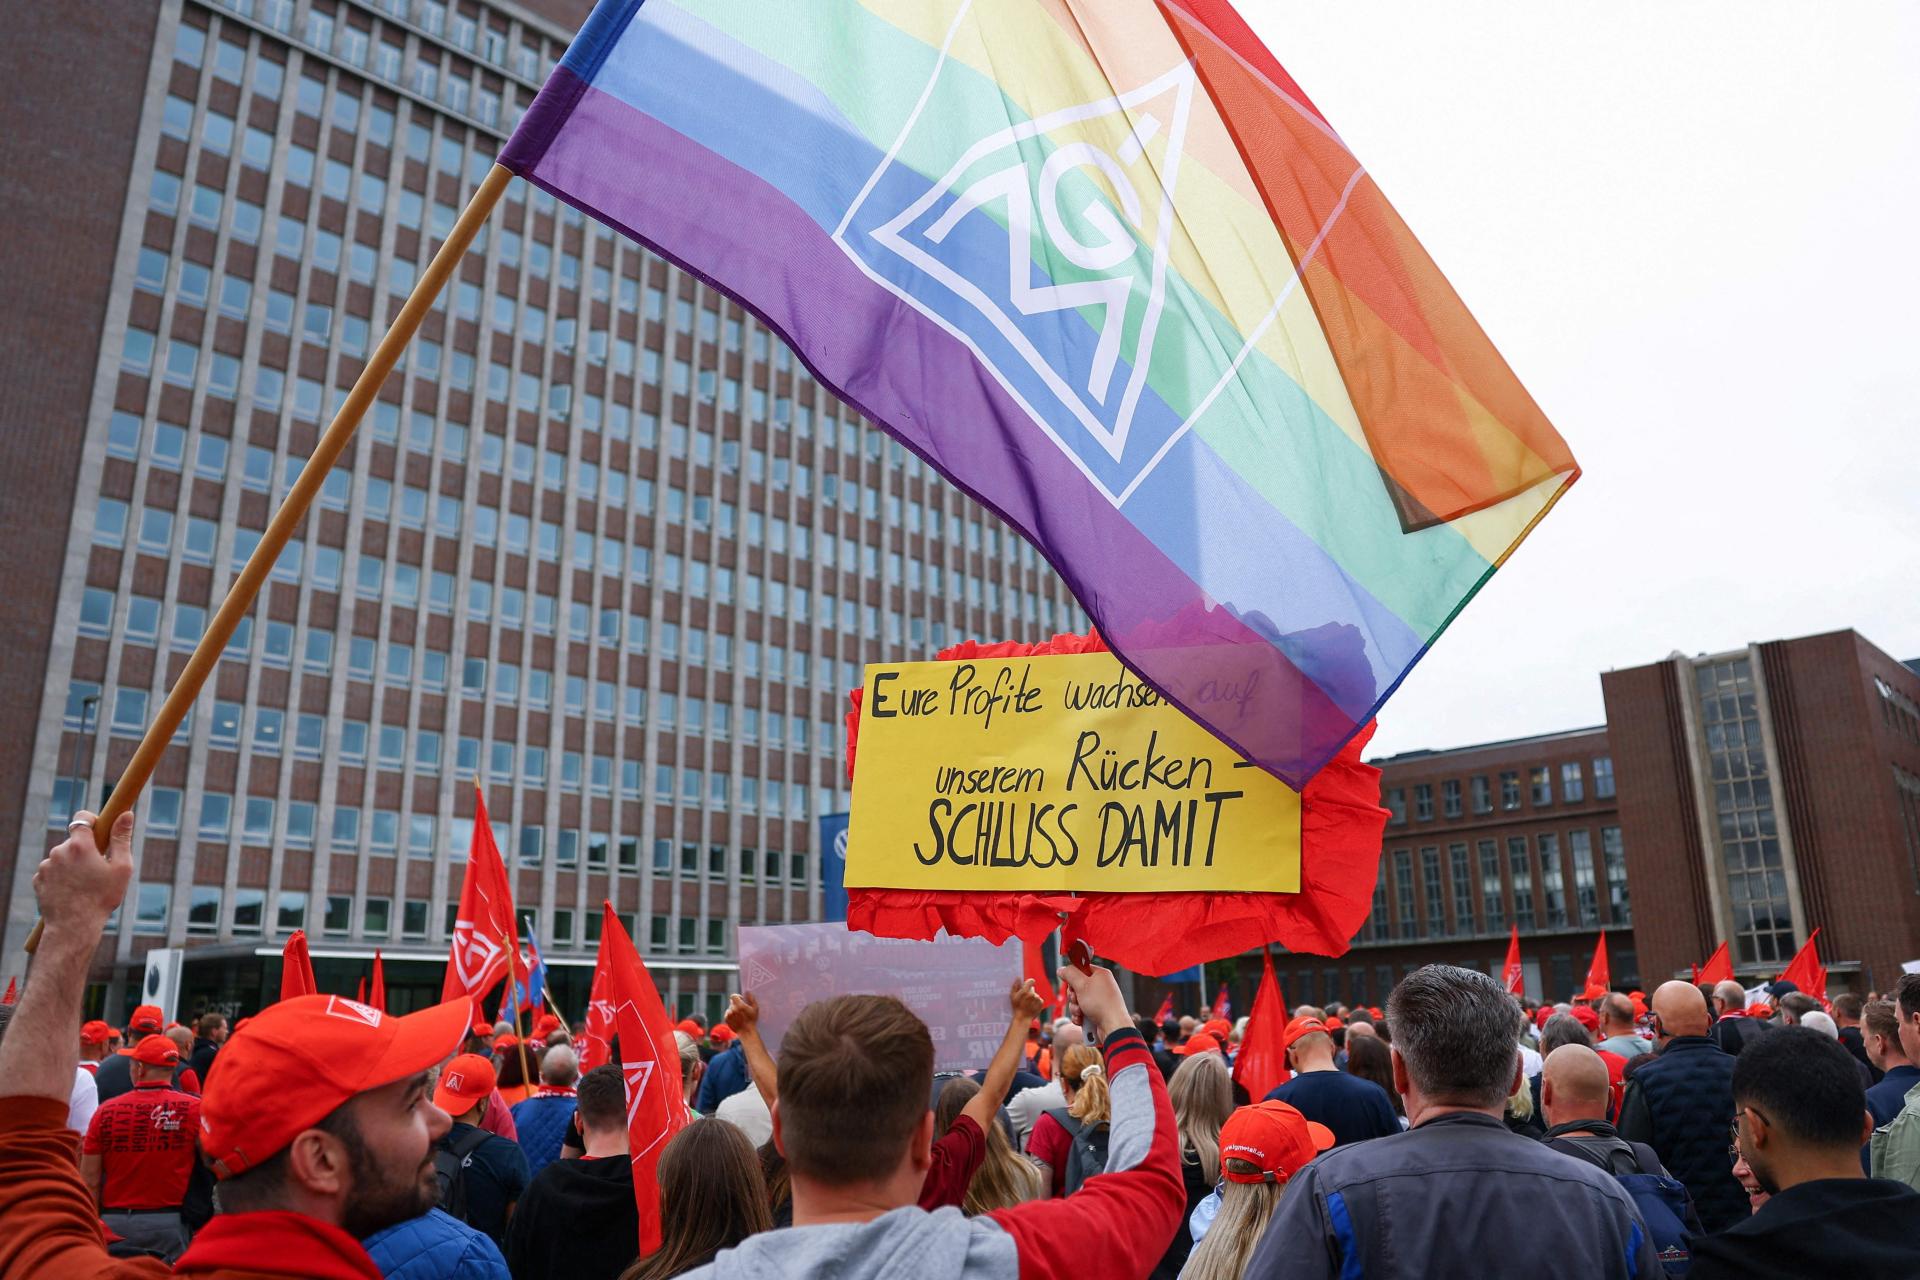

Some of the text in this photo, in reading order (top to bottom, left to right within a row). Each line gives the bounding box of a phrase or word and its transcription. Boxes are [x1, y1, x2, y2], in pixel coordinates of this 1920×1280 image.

[871, 672, 939, 718] Eure
[949, 663, 1043, 730] Profite
[1199, 669, 1260, 718] auf
[935, 766, 1044, 796] unserem
[1066, 730, 1212, 792] Rücken
[913, 790, 1244, 869] SCHLUSS DAMIT
